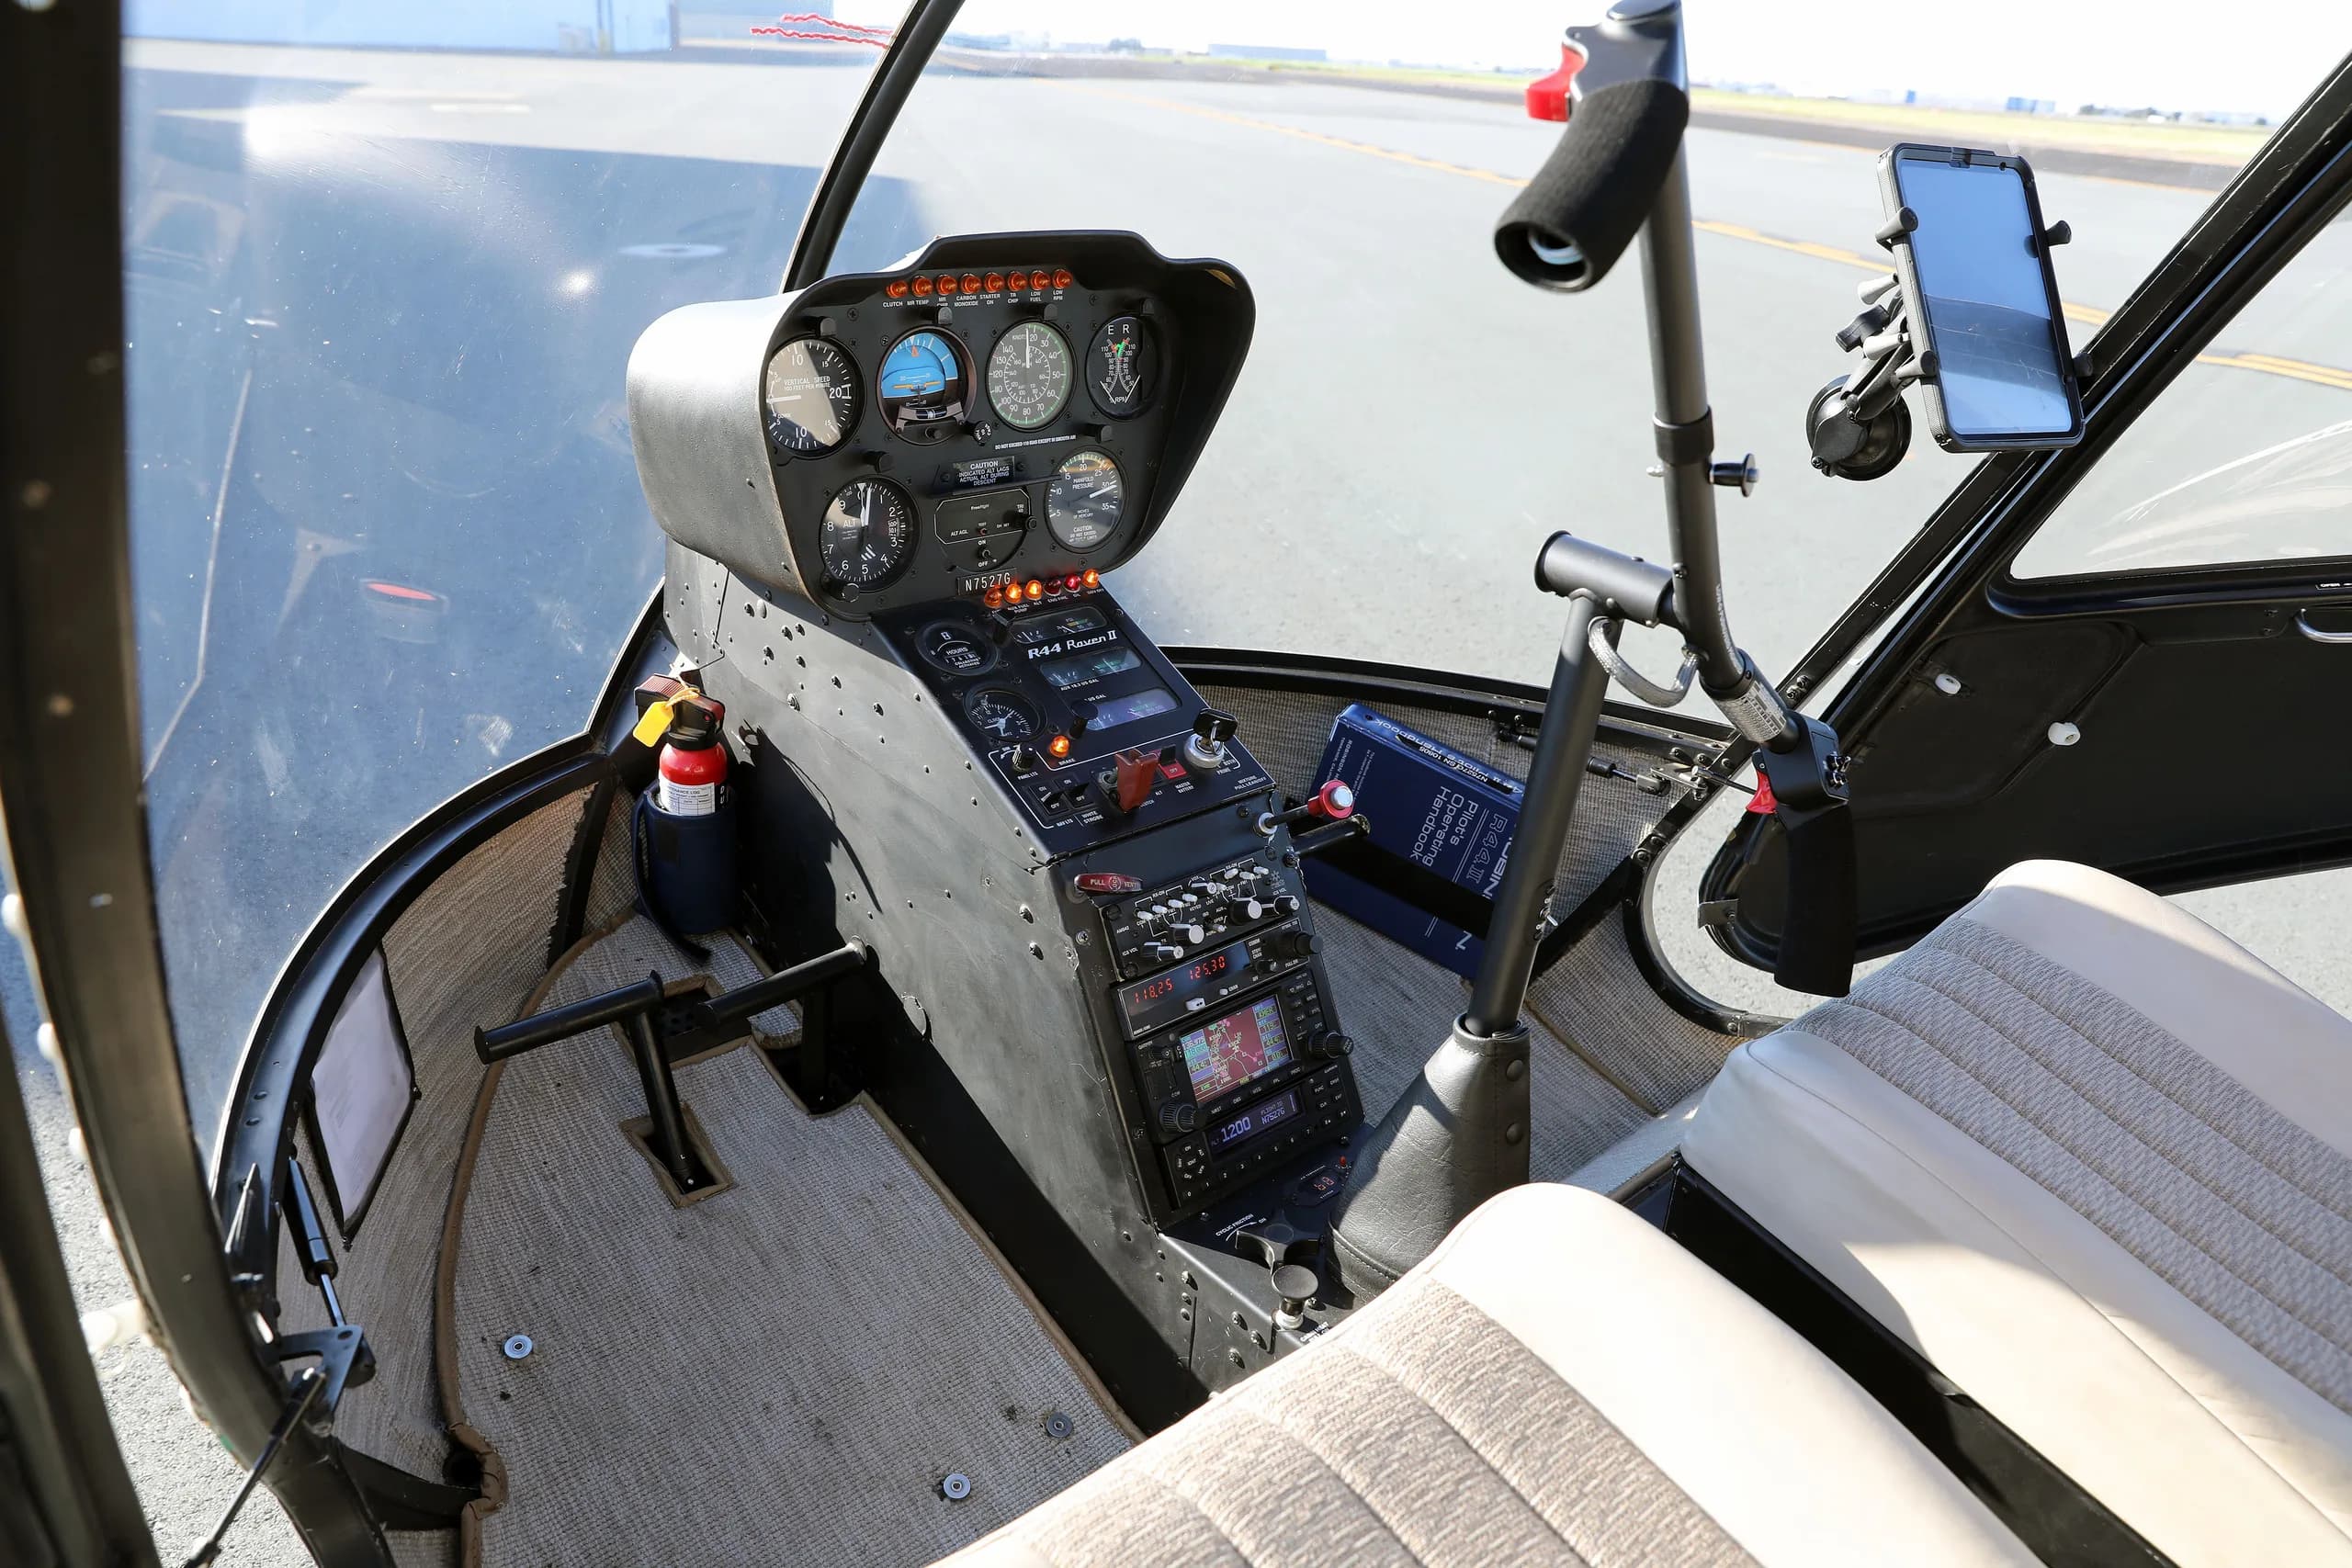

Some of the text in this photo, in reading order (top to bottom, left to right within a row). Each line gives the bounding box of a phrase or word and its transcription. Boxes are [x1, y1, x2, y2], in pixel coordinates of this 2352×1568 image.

[1108, 323, 1130, 335] E R
[1030, 333, 1038, 342] 20
[792, 354, 804, 366] 10
[1048, 351, 1057, 359] 40
[996, 356, 1007, 365] 130
[992, 370, 1003, 378] 120
[829, 387, 842, 399] 20
[1047, 389, 1056, 398] 60
[796, 426, 808, 438] 10
[970, 460, 999, 469] CAUTION
[958, 469, 986, 478] INDICATED
[959, 475, 978, 483] ACTUAL
[838, 500, 846, 510] 9
[1102, 502, 1109, 511] 35
[888, 507, 896, 517] 2
[827, 521, 834, 531] 8
[842, 519, 856, 528] ALT
[890, 536, 898, 547] 3
[827, 544, 834, 554] 7
[880, 553, 888, 563] 4
[842, 560, 849, 570] 6
[862, 564, 868, 574] 5
[965, 572, 1011, 592] N7527G
[1028, 630, 1117, 659] R44 Raven II
[945, 647, 968, 656] HOURS
[1058, 758, 1076, 766] BRAKE
[1443, 758, 1457, 769] SN
[1178, 785, 1193, 794] BATTERY
[1083, 815, 1103, 824] STROBE
[1409, 785, 1452, 861] Handbook
[1450, 799, 1479, 846] Pilot's
[1422, 793, 1464, 867] Operating
[1475, 813, 1509, 865] R44
[1135, 955, 1226, 1004] 118.25 125.30
[1315, 1085, 1325, 1093] FUNC
[1261, 1104, 1276, 1116] FLIGHT
[1261, 1108, 1285, 1125] N7527G
[1221, 1116, 1251, 1143] 1200
[1216, 1213, 1254, 1236] CYCLIC FRICTION
